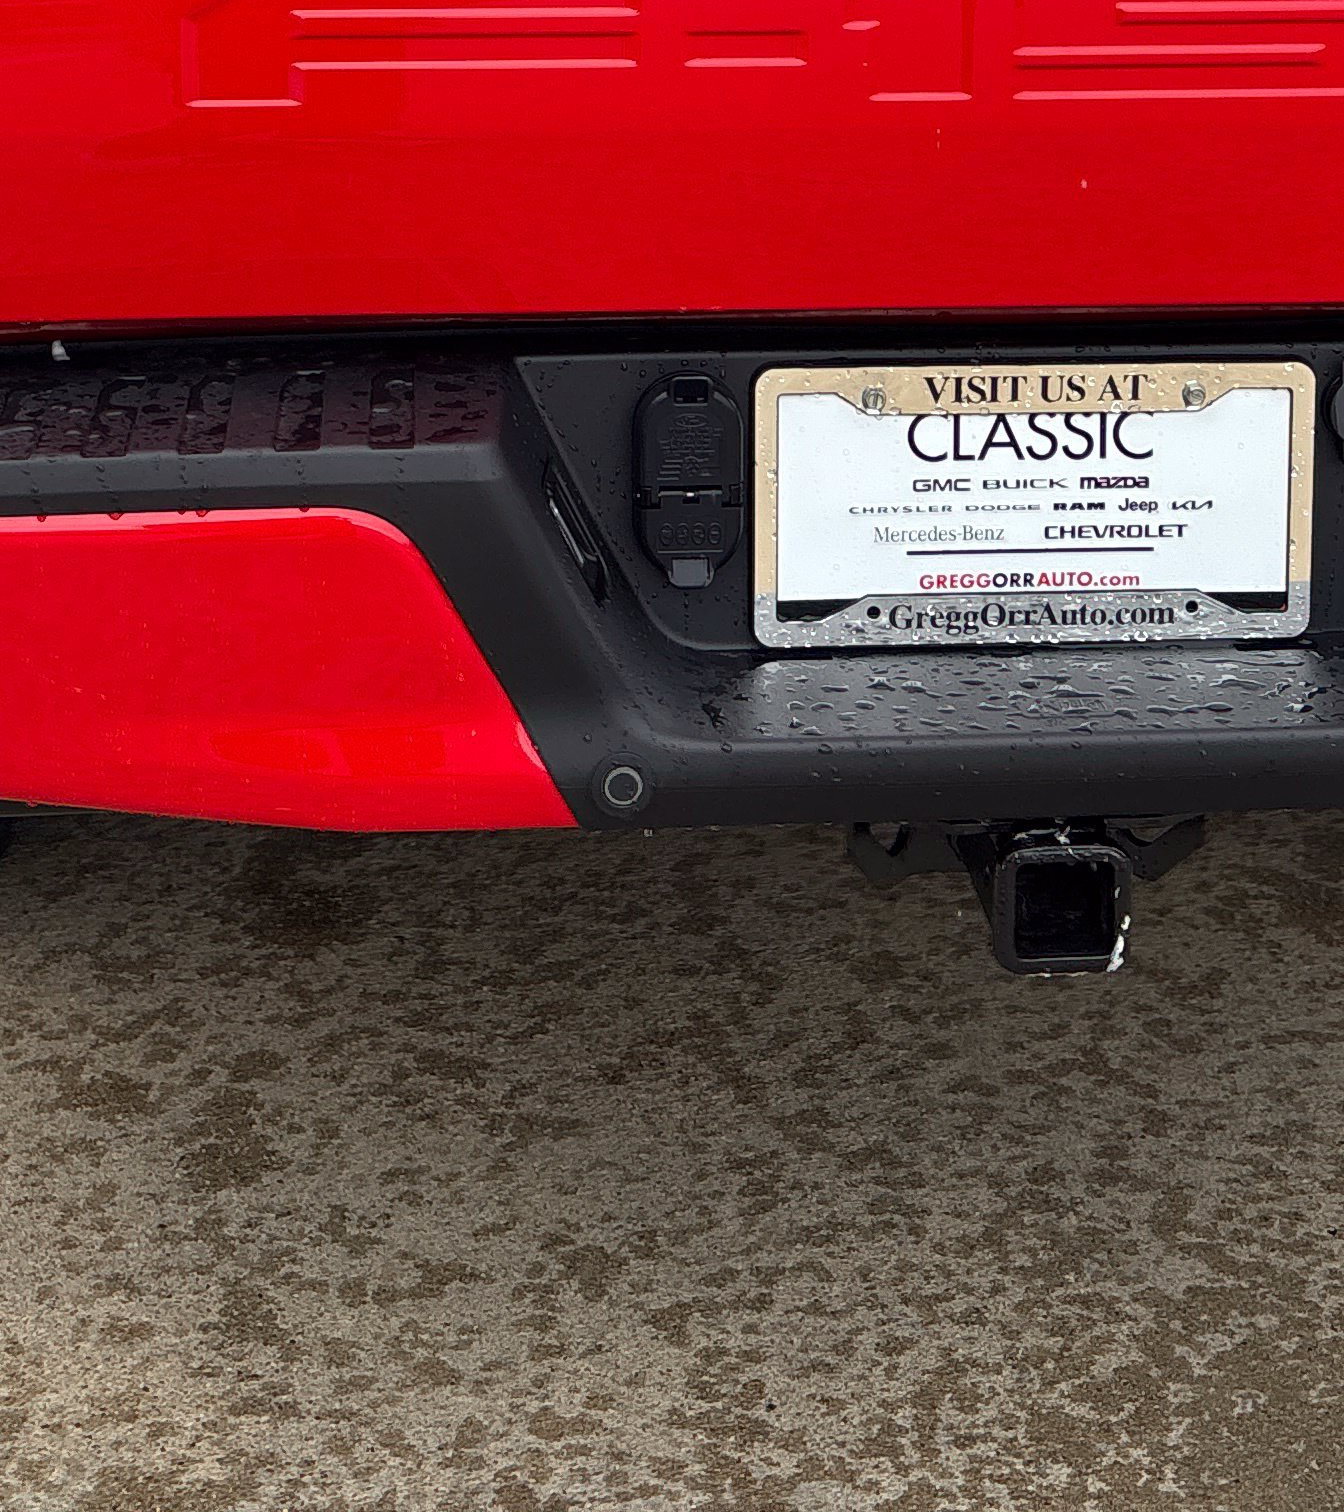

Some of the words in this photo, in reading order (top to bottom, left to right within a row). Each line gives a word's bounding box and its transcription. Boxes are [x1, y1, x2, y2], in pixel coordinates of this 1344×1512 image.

[923, 375, 1028, 404] VISIT
[1039, 374, 1086, 403] US
[1097, 373, 1148, 402] AT
[906, 412, 1154, 463] CLASSIC
[913, 478, 971, 493] GMC
[982, 478, 1069, 490] BUICK
[849, 505, 953, 515] CHRYSLER
[965, 504, 1041, 512] DODGE
[1053, 501, 1106, 511] RAM
[1118, 497, 1159, 514] Jeep
[873, 524, 1006, 543] Mercedes-Benz
[1044, 523, 1189, 539] CHEVROLET
[919, 571, 1140, 589] GREGGORRAUTO.com
[888, 602, 1175, 635] GreggOrrAuto.com
